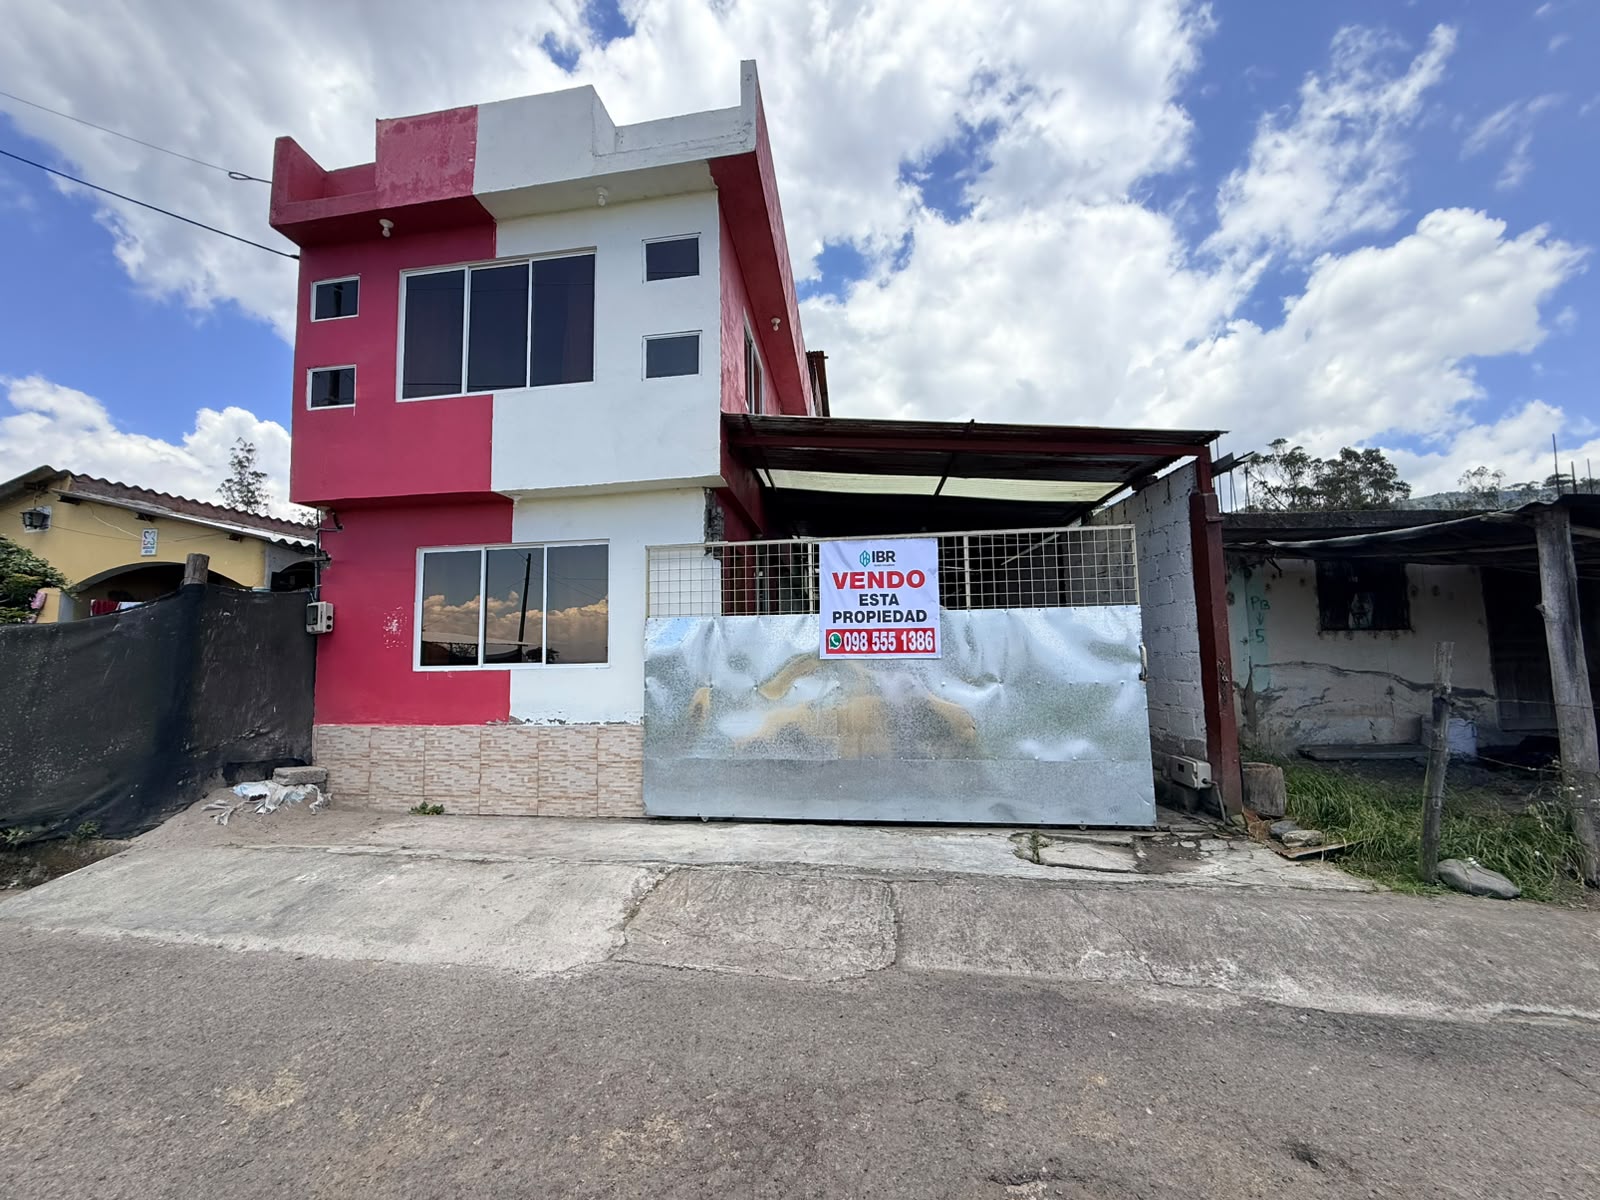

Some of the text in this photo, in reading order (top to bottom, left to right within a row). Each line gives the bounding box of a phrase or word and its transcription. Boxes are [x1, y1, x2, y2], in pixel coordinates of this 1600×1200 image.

[872, 551, 896, 562] IBR
[832, 570, 925, 589] VENDO
[859, 594, 899, 606] ESTA
[832, 610, 927, 623] PROPIEDAD
[844, 631, 933, 651] 098 555 1386
